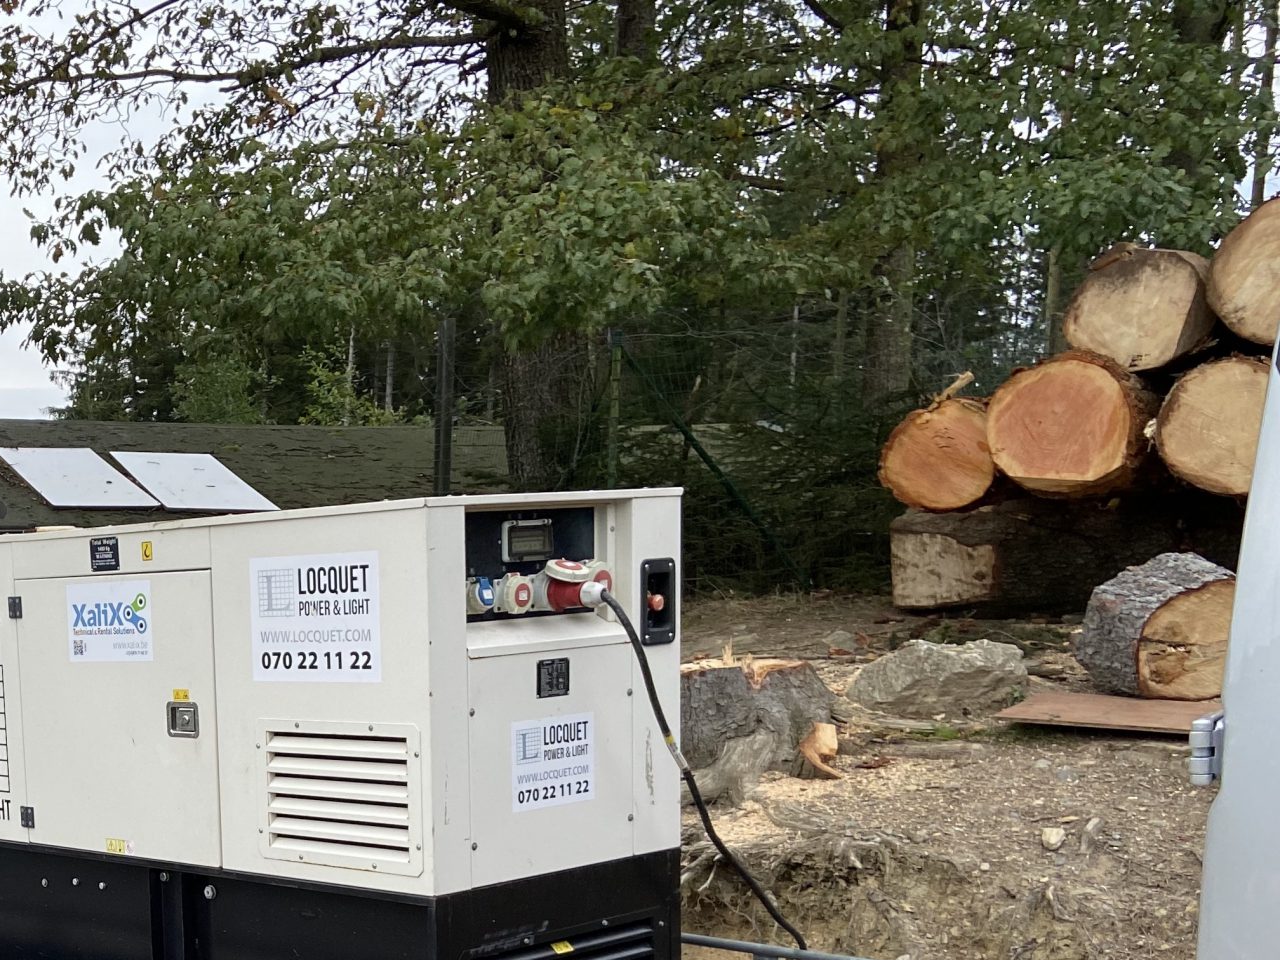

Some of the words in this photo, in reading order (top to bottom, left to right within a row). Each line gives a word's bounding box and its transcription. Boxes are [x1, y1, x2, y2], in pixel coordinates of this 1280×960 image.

[298, 564, 370, 595] LOCQUET
[72, 602, 124, 627] XaliX
[333, 599, 341, 616] &
[343, 598, 371, 615] LIGHT
[113, 627, 135, 635] Solutions
[260, 629, 372, 644] WWW.LOCQUET.COM
[261, 651, 293, 670] 070
[297, 651, 319, 670] 22
[323, 651, 343, 670] 11
[350, 650, 372, 670] 22
[543, 721, 588, 746] LOCQUET
[543, 747, 564, 761] POWER
[565, 746, 571, 758] &
[572, 744, 589, 757] LIGHT
[517, 764, 589, 785] WWW.LOCQUET.COM
[518, 788, 540, 804] 070
[542, 785, 557, 800] 22
[559, 783, 572, 797] 11
[575, 780, 589, 794] 22
